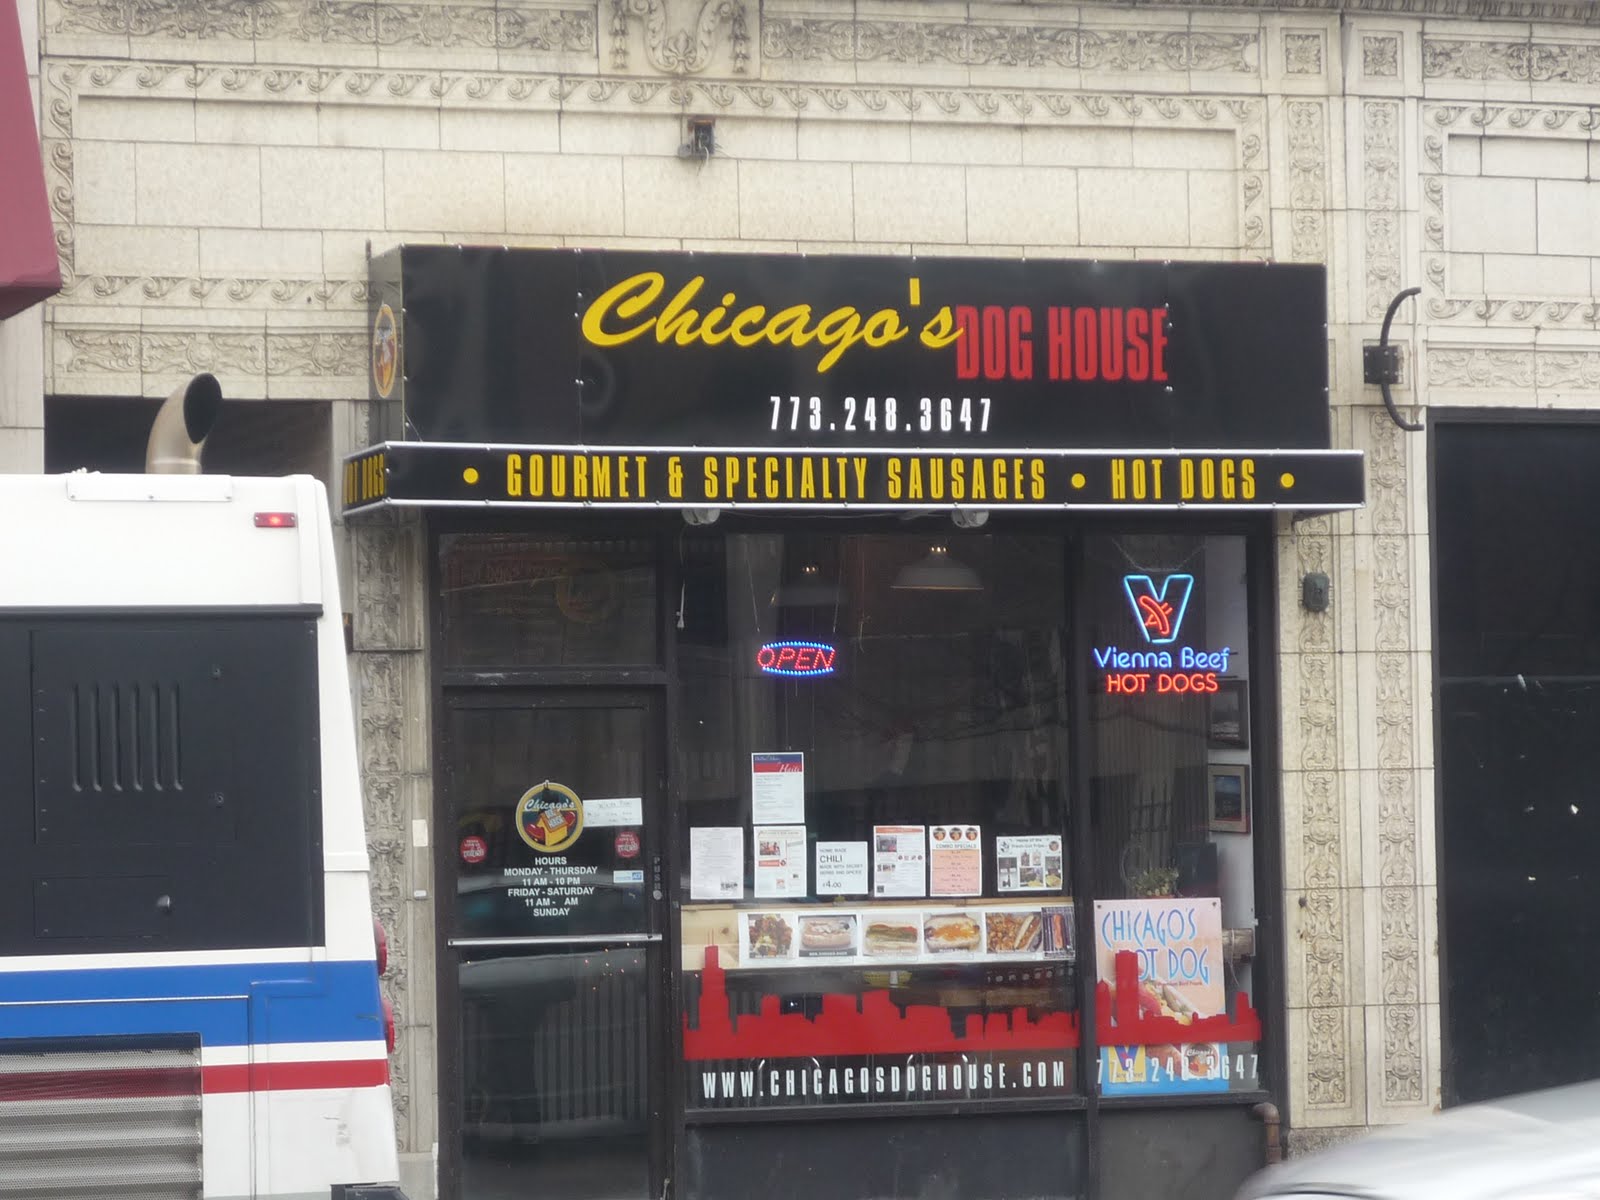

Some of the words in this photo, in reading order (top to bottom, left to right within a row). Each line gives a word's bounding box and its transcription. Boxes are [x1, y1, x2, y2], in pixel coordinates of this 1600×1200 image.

[581, 271, 964, 374] Chicago's
[955, 305, 1034, 380] DOG
[1048, 306, 1168, 381] HOUSE
[769, 395, 992, 433] 773.248.3647
[506, 454, 648, 499] GOURMET
[668, 457, 684, 498] &
[704, 456, 867, 499] SPECIALTY
[888, 458, 1046, 500] SAUSAGES
[1111, 458, 1163, 499] HOT
[1181, 458, 1256, 500] DOGS
[756, 647, 836, 670] OPEN
[1093, 646, 1173, 669] Vienna
[1181, 646, 1231, 673] Beef
[1106, 673, 1150, 693] HOT
[1157, 672, 1219, 693] DOGS
[524, 798, 576, 813] Chicago's
[535, 856, 567, 866] HOURS
[820, 855, 843, 863] CHILI
[504, 868, 543, 877] MONDAY
[550, 866, 598, 876] THURSDAY
[533, 878, 549, 886] AM
[555, 878, 565, 886] 10
[567, 877, 580, 886] PM
[508, 888, 540, 897] FRIDAY
[547, 886, 594, 897] SATURDAY
[525, 899, 534, 907] 11
[536, 898, 550, 907] AM
[565, 897, 578, 906] AM
[533, 908, 570, 917] SUNDAY
[1102, 907, 1195, 949] CHICAGO'S
[1168, 947, 1209, 985] DOG
[702, 1061, 1065, 1098] WWW.CHICAGOSDOGHOUSE.COM
